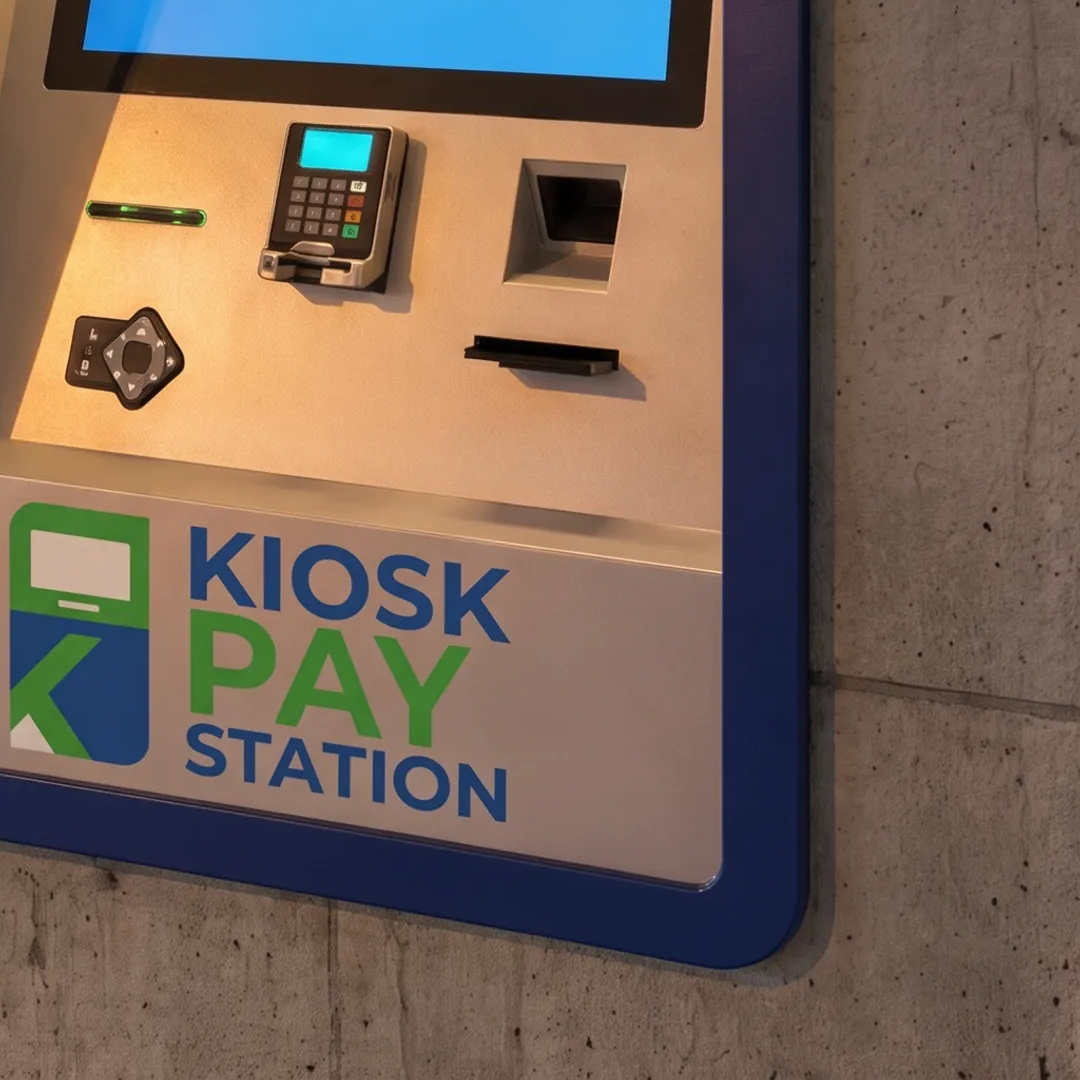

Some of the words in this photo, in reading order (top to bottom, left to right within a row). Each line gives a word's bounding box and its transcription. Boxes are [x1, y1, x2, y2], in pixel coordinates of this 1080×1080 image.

[190, 526, 511, 644] KIOSK
[190, 608, 471, 748] PAY
[185, 723, 507, 822] STATION
